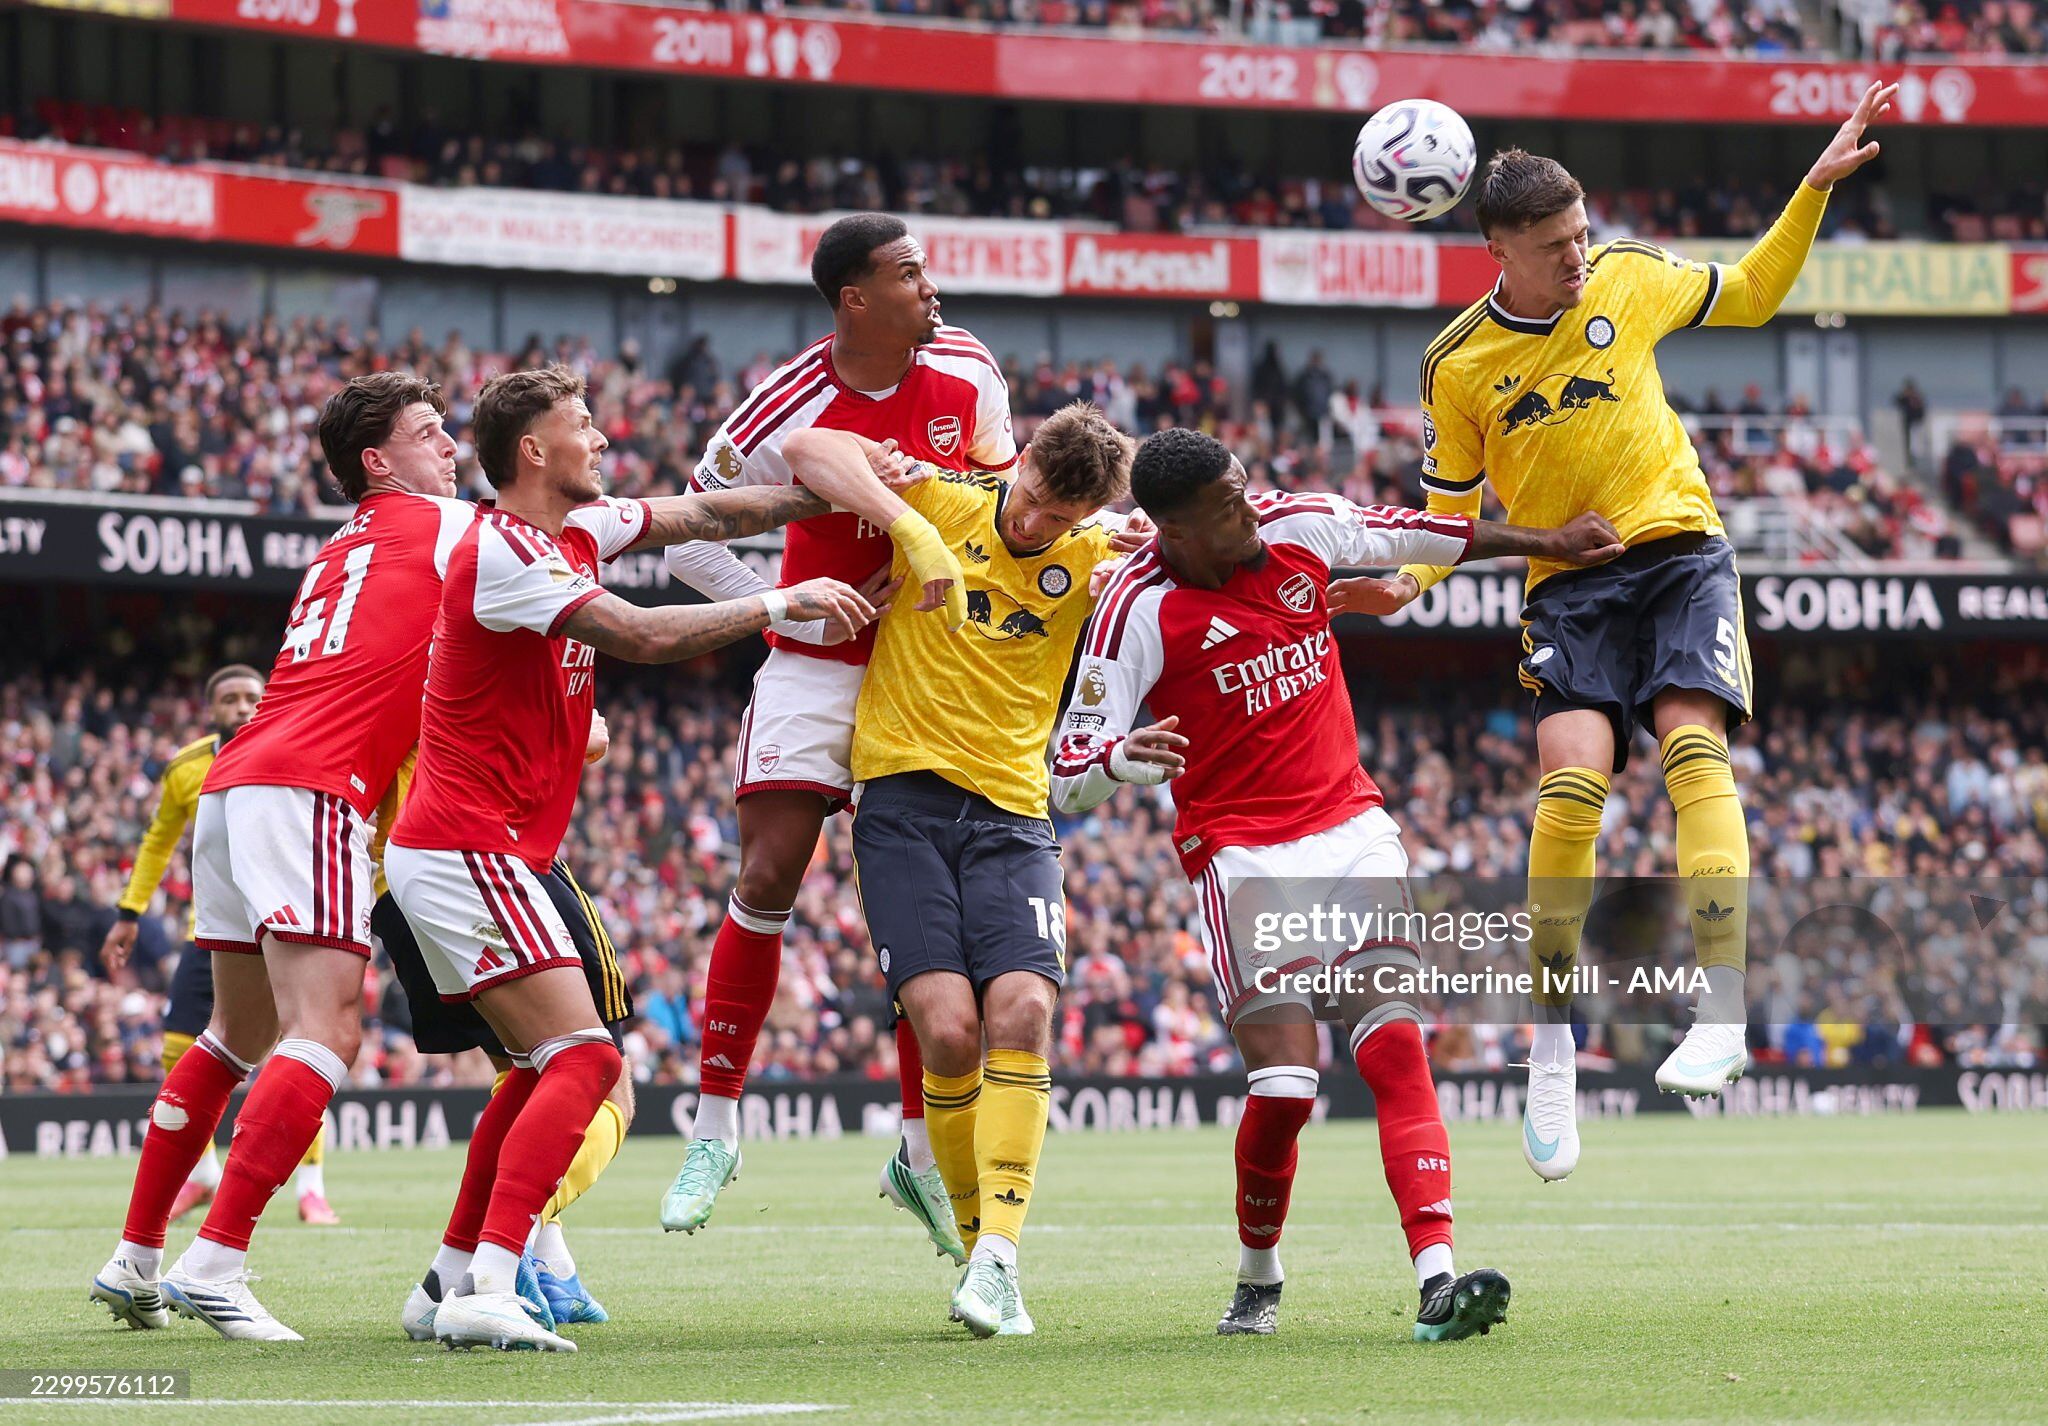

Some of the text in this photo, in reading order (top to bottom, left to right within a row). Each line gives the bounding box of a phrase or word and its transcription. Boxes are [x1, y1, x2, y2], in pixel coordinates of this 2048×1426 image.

[653, 18, 732, 64] 2011
[1200, 53, 1298, 100] 2012
[1069, 235, 1230, 292] Arsenal
[1796, 251, 1998, 303] TRALIA
[933, 421, 957, 432] Arsenal
[98, 512, 253, 578] SOBHA
[280, 544, 375, 664] 41
[1283, 579, 1305, 597] Arsenal
[1755, 576, 1943, 631] SOBHA
[1211, 630, 1330, 694] Emirate
[1714, 617, 1736, 671] 5
[1246, 682, 1271, 716] FLY
[1027, 897, 1066, 953] 18
[709, 1019, 737, 1035] AFC
[671, 1092, 843, 1141] SBHA
[1417, 1157, 1448, 1172] AFC
